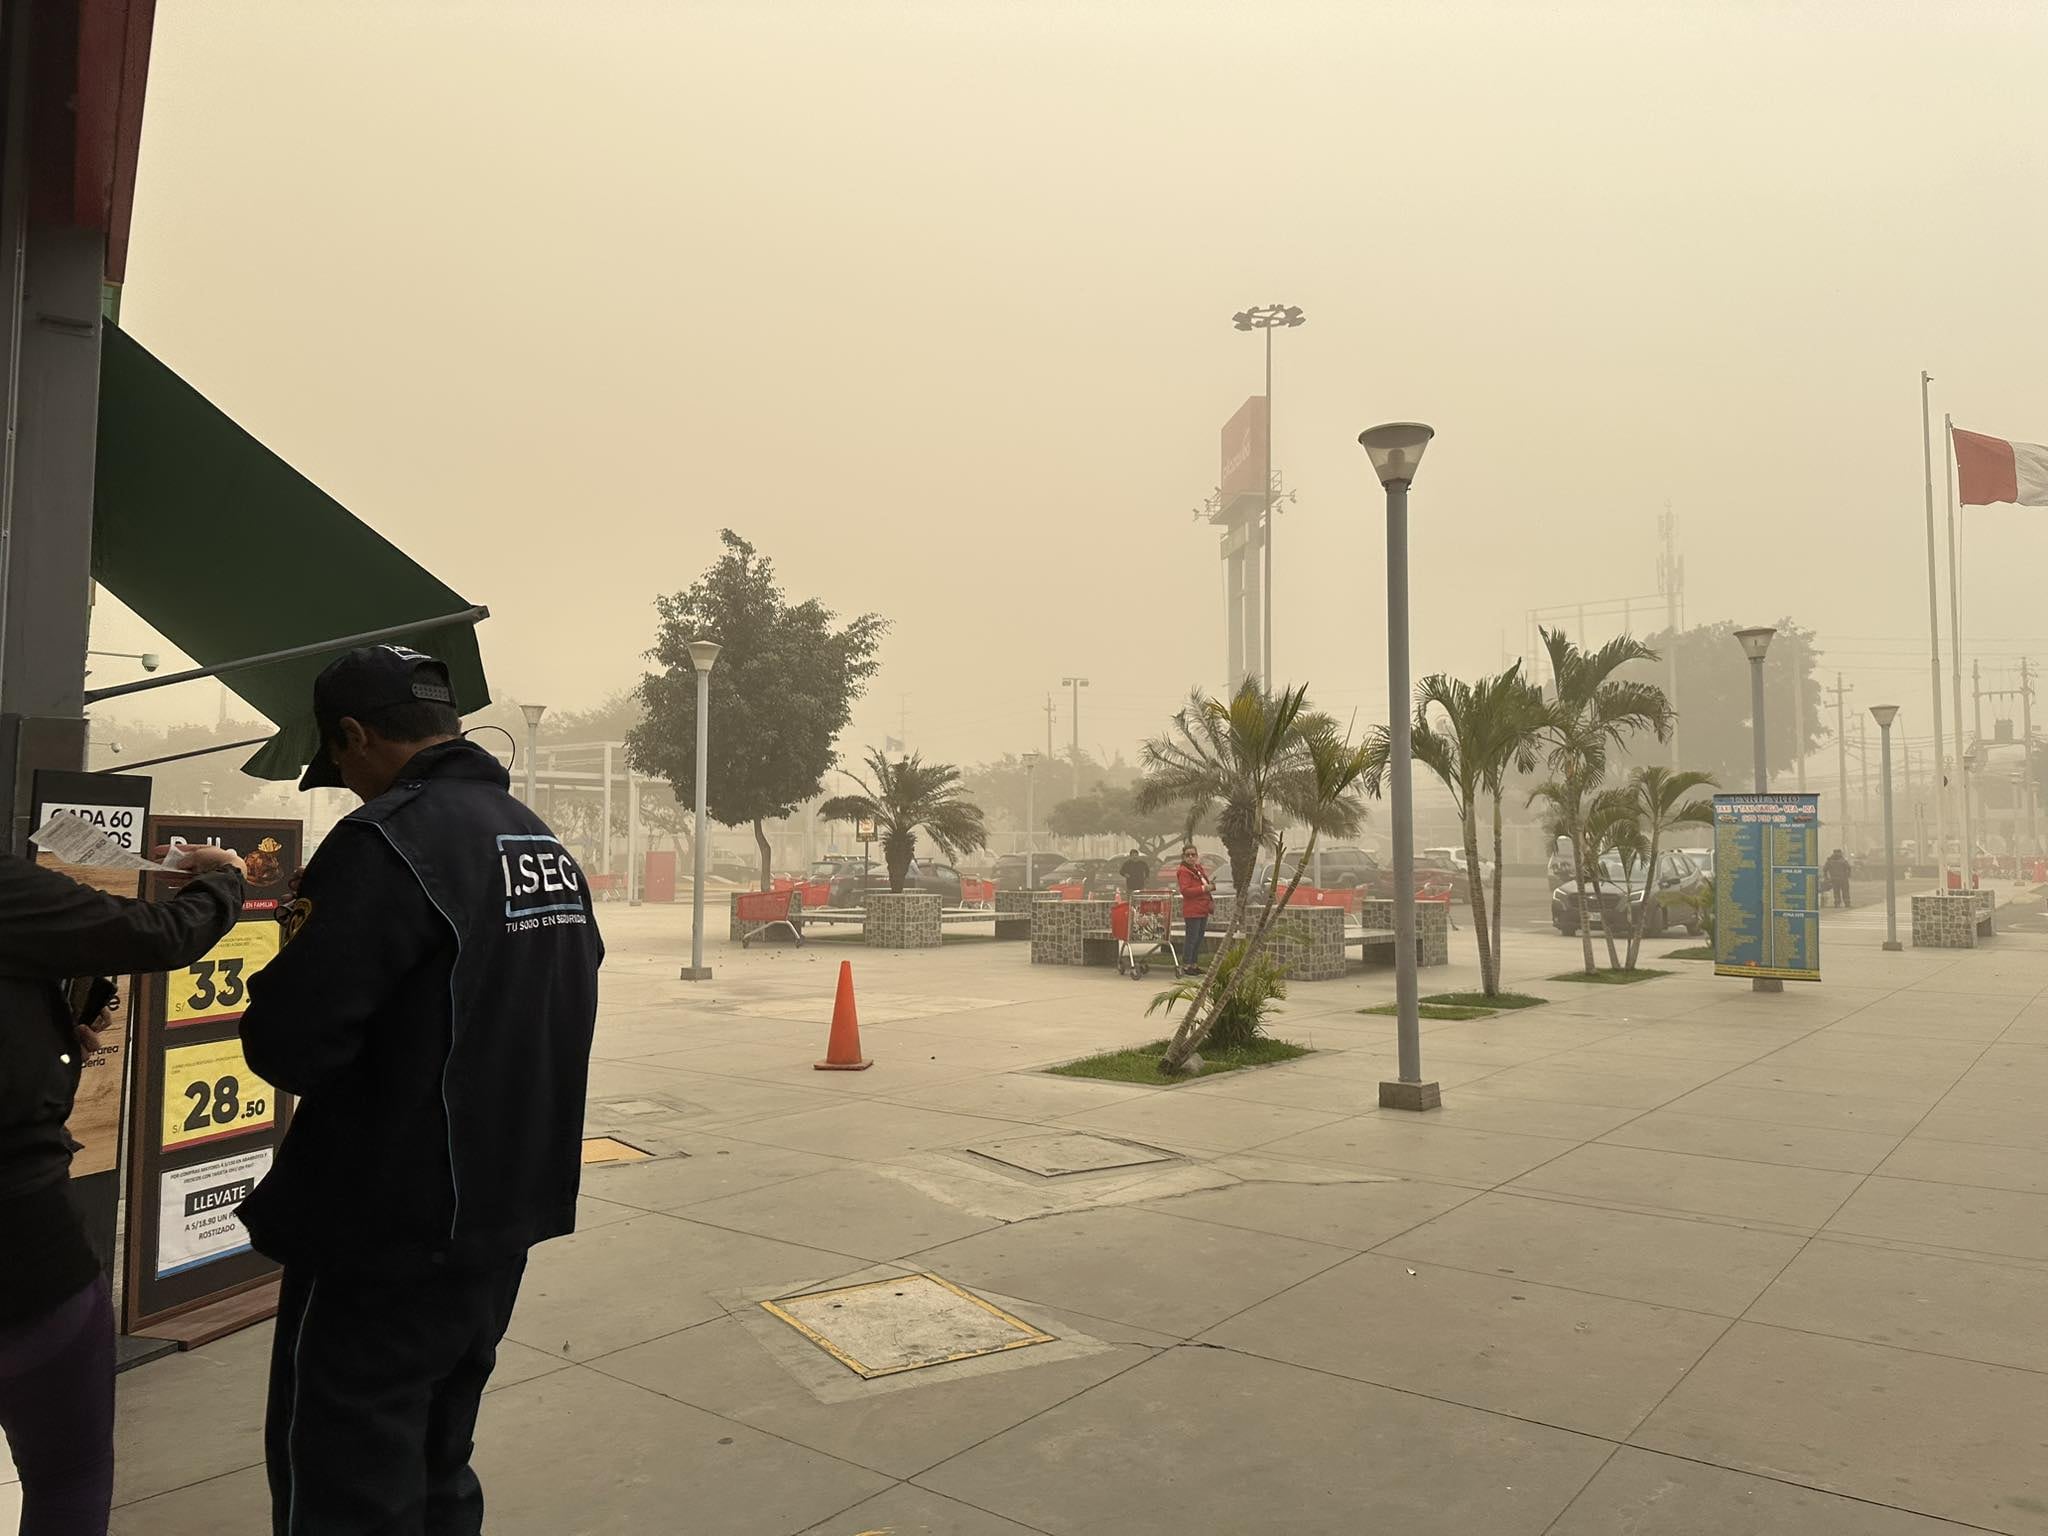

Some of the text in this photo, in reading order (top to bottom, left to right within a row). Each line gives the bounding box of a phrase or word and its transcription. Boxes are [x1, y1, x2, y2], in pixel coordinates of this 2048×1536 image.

[110, 811, 133, 828] 60
[501, 853, 578, 896] I.SEG
[506, 922, 517, 933] TU
[542, 915, 556, 926] EN
[193, 1185, 247, 1211] LLEVATE
[184, 1224, 190, 1232] A
[217, 1213, 228, 1223] UN
[198, 1223, 236, 1240] ROSTIZADO
